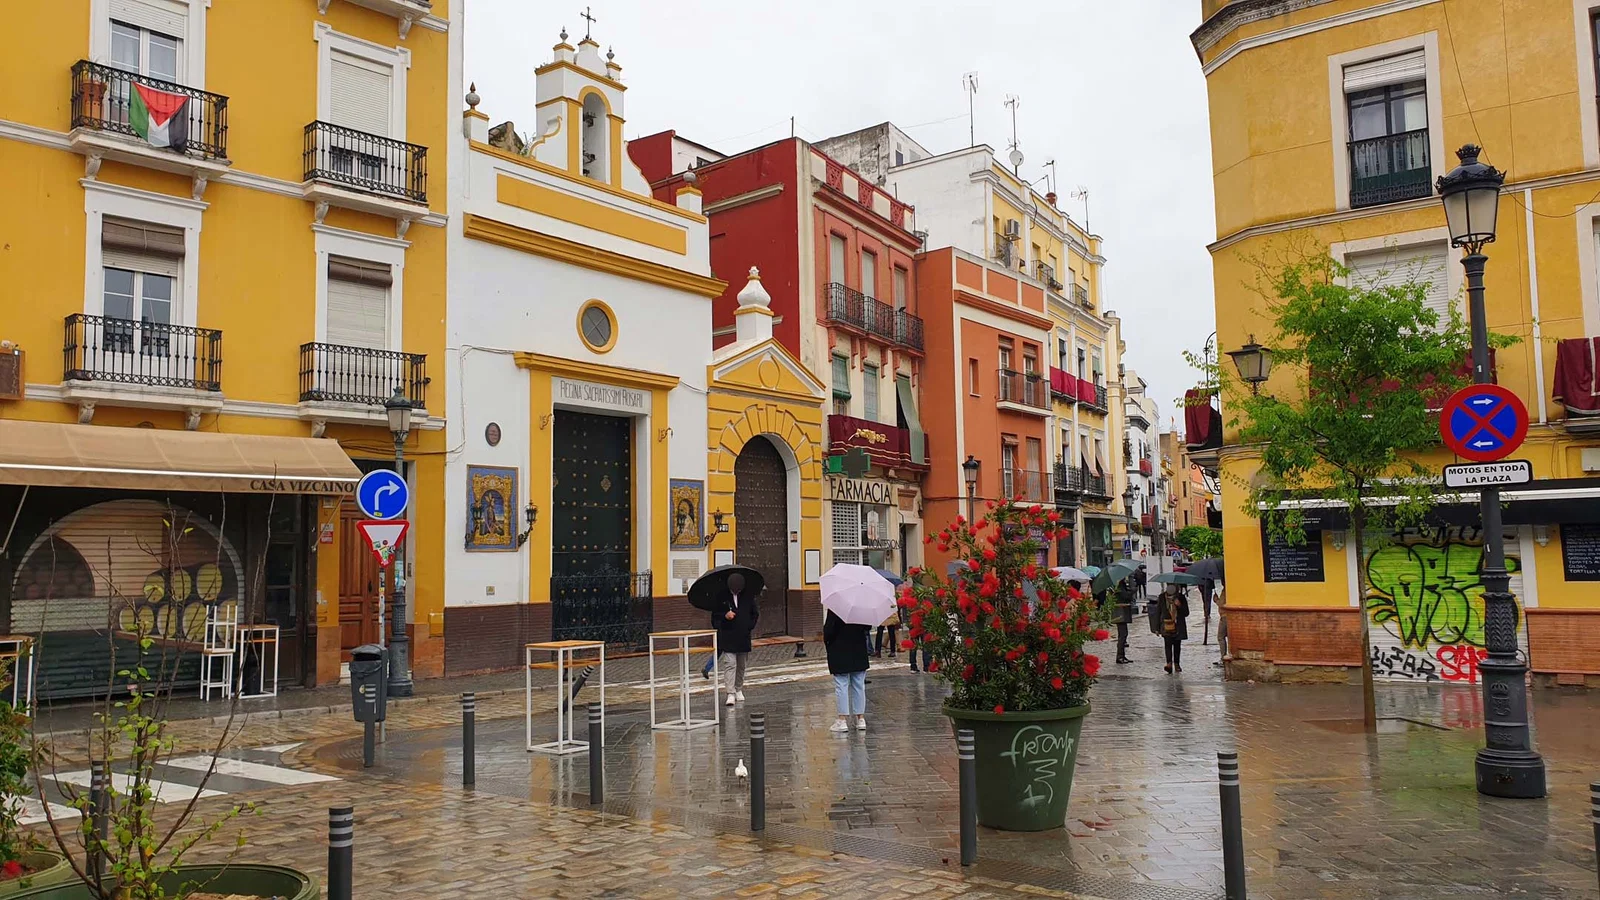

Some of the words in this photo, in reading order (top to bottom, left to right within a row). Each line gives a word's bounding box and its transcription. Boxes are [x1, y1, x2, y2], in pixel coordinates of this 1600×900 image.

[1448, 467, 1481, 475] MOTOS
[1500, 464, 1526, 472] TODA
[1480, 475, 1512, 483] PLAZA
[250, 480, 286, 491] CASA
[289, 481, 355, 493] VIZCAINO
[830, 478, 892, 504] FARMACIA
